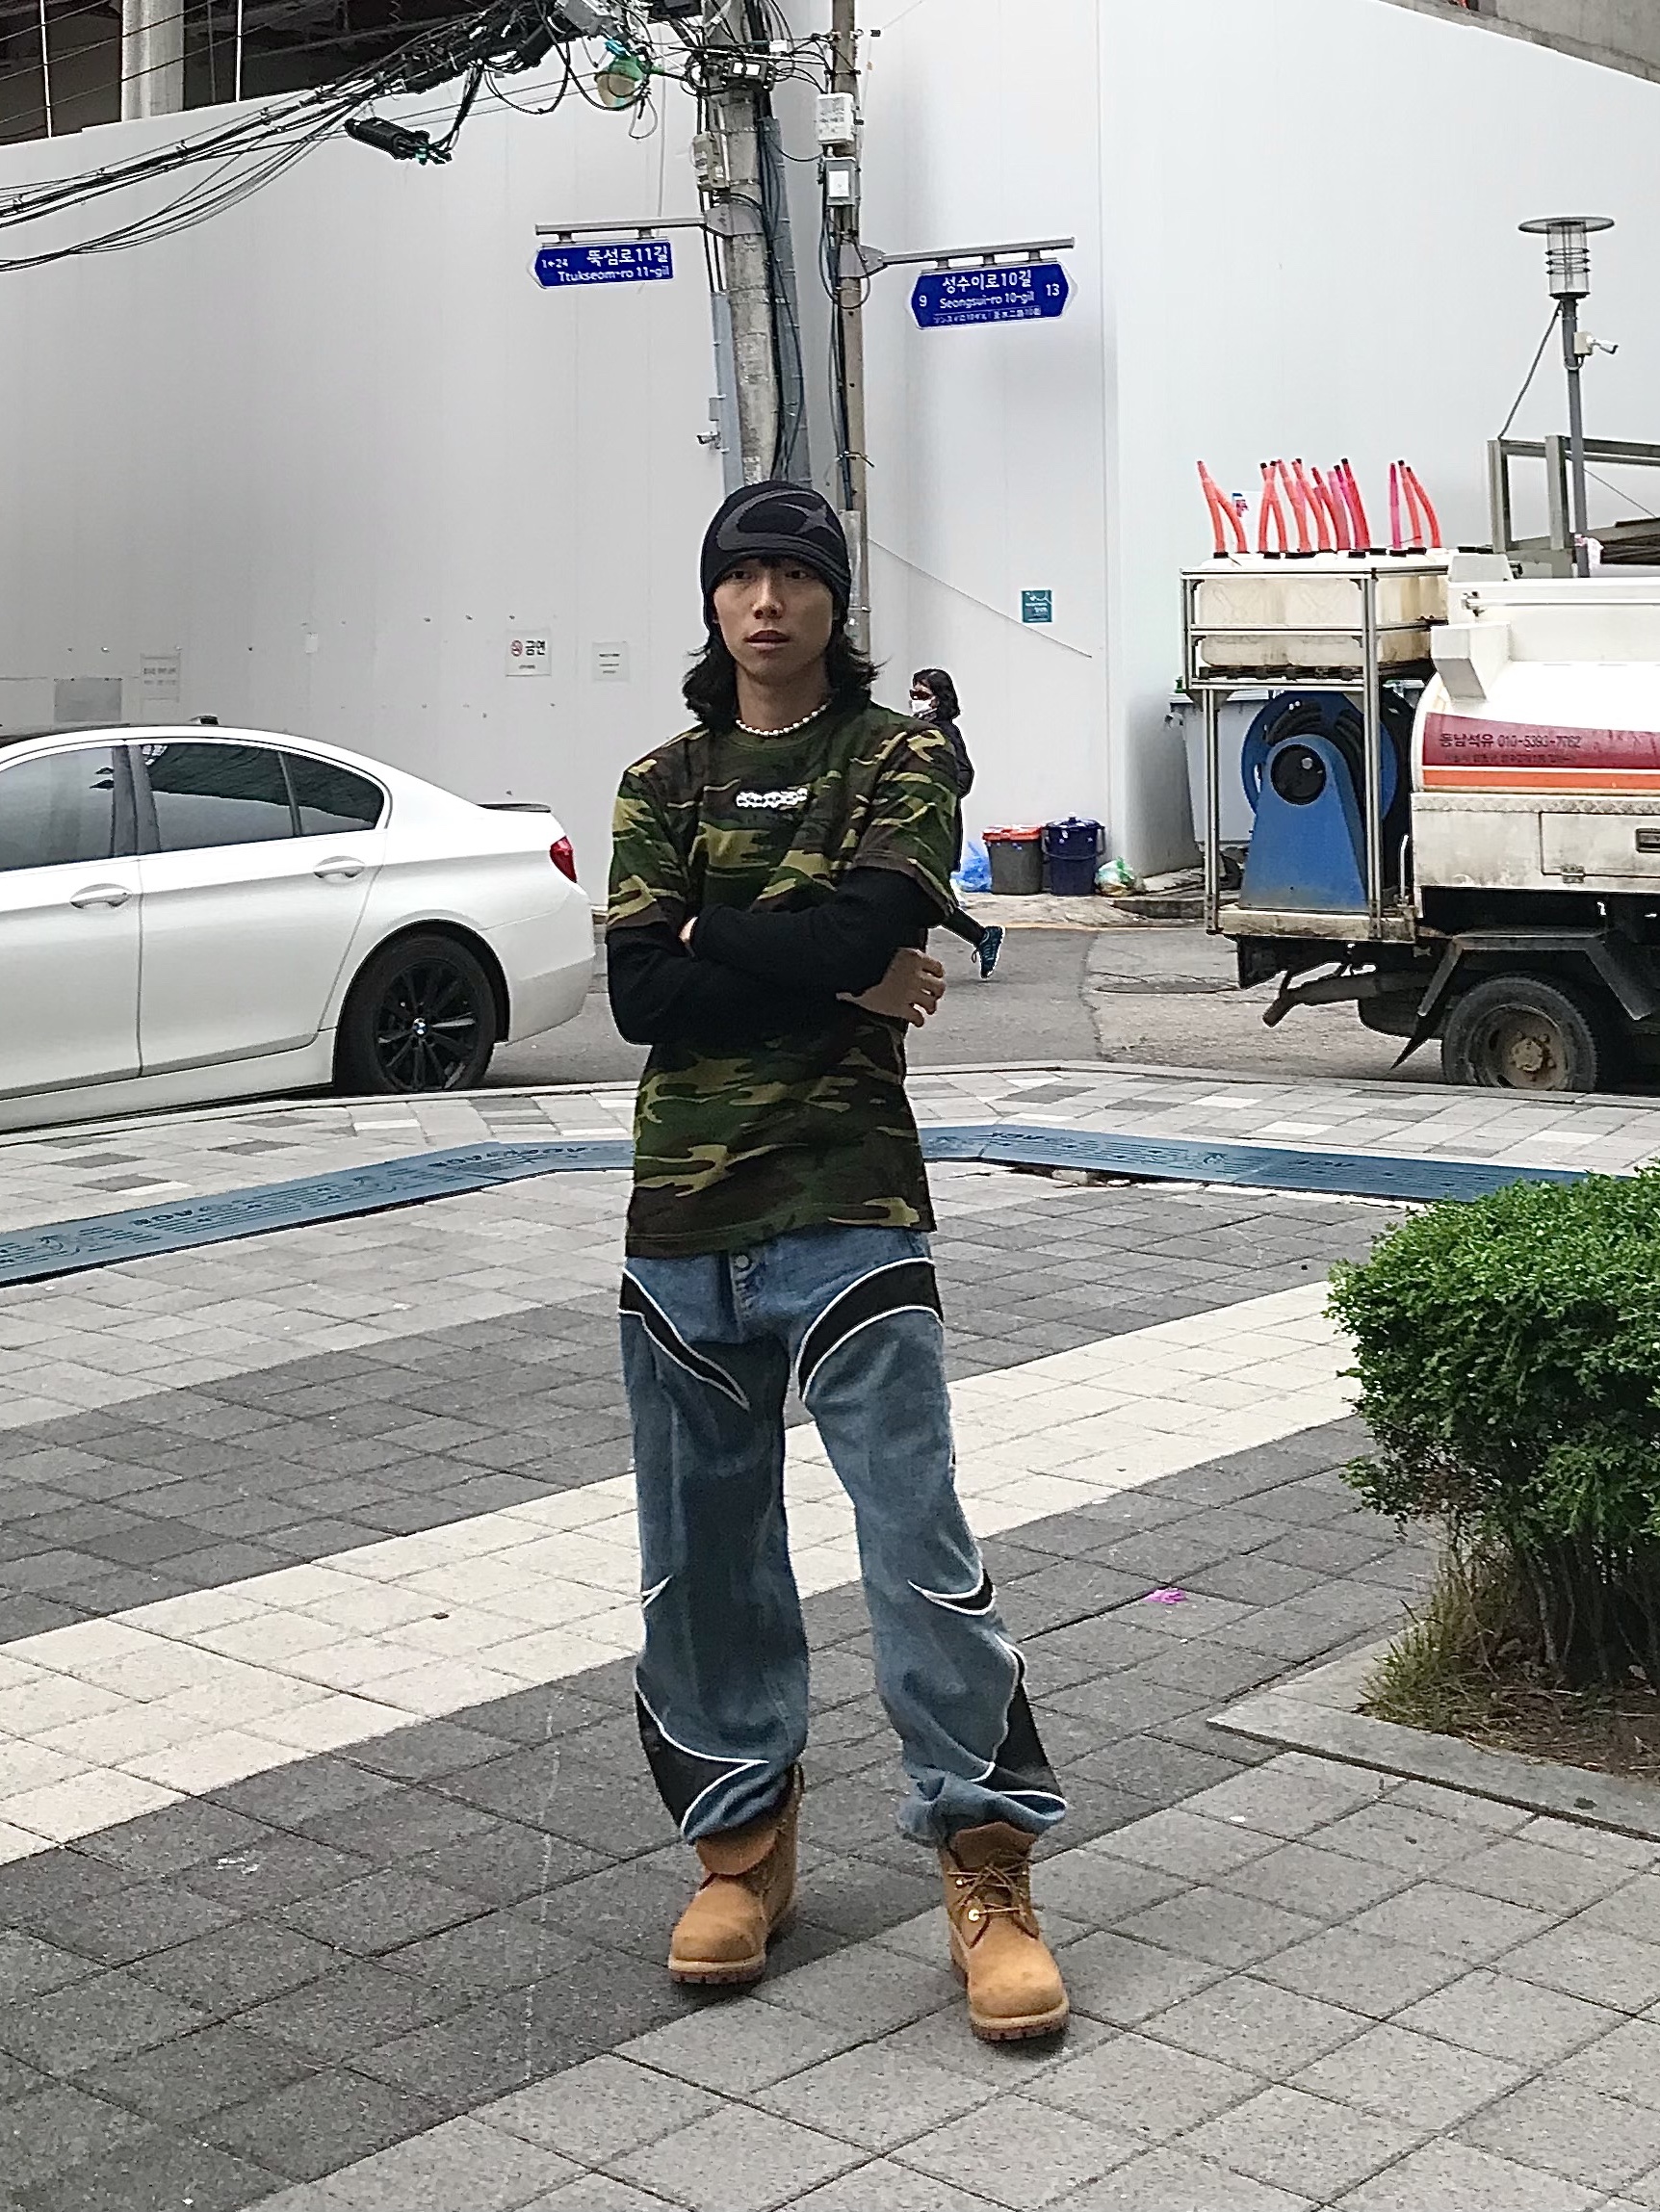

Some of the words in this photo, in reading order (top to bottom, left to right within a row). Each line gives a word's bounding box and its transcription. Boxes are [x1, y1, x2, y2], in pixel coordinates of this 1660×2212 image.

[586, 245, 669, 267] 뚝섬로11길
[558, 270, 634, 282] Ttukseom-ro
[636, 265, 670, 278] 11-gil
[942, 270, 1032, 294] 성수이로10길
[1004, 291, 1035, 304] 10-gil
[1046, 283, 1060, 297] 13
[919, 295, 927, 307] 9
[525, 639, 546, 656] 금연
[1439, 733, 1494, 747] 동남석유
